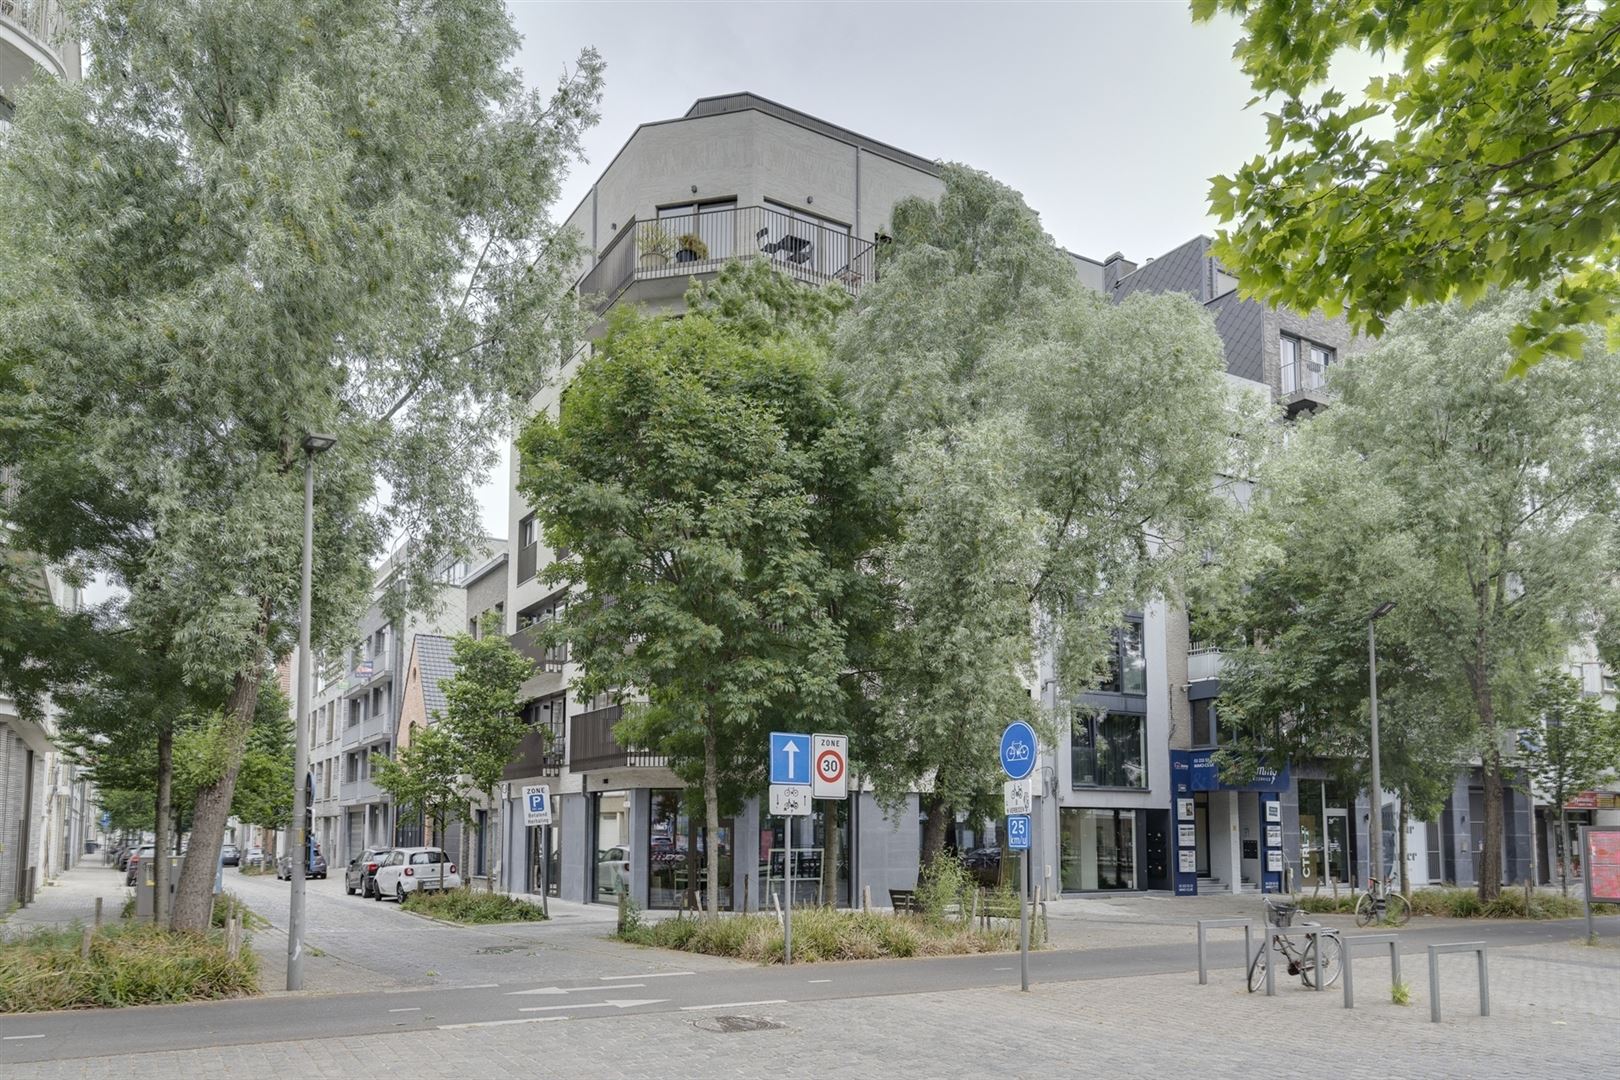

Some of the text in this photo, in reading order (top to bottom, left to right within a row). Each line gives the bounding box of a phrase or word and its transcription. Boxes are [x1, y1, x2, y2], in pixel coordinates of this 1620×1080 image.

[821, 739, 840, 747] ZONE
[823, 760, 838, 772] 30
[532, 796, 541, 807] P
[1011, 820, 1025, 834] 25
[1010, 835, 1026, 844] km/u
